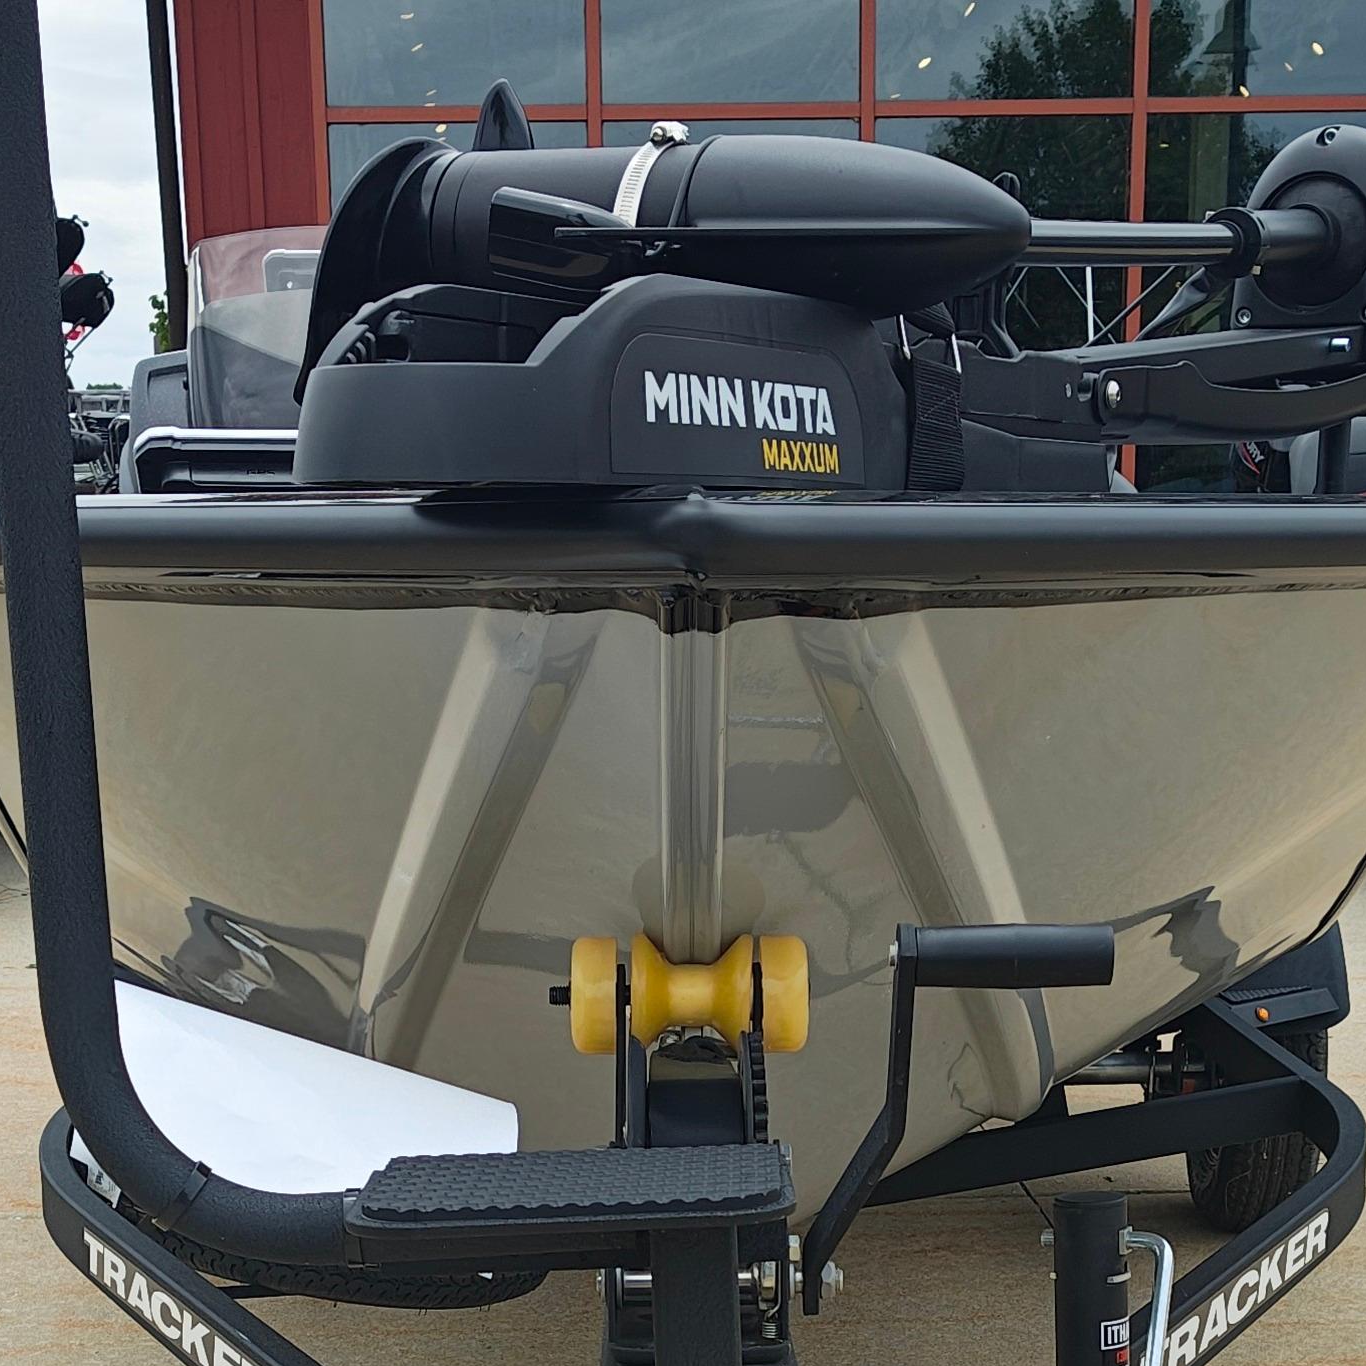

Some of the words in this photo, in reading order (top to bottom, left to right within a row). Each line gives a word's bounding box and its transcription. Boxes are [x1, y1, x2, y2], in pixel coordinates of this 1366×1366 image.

[645, 370, 746, 428] MINN
[751, 380, 836, 436] KOTA
[762, 438, 839, 474] MAXXUM
